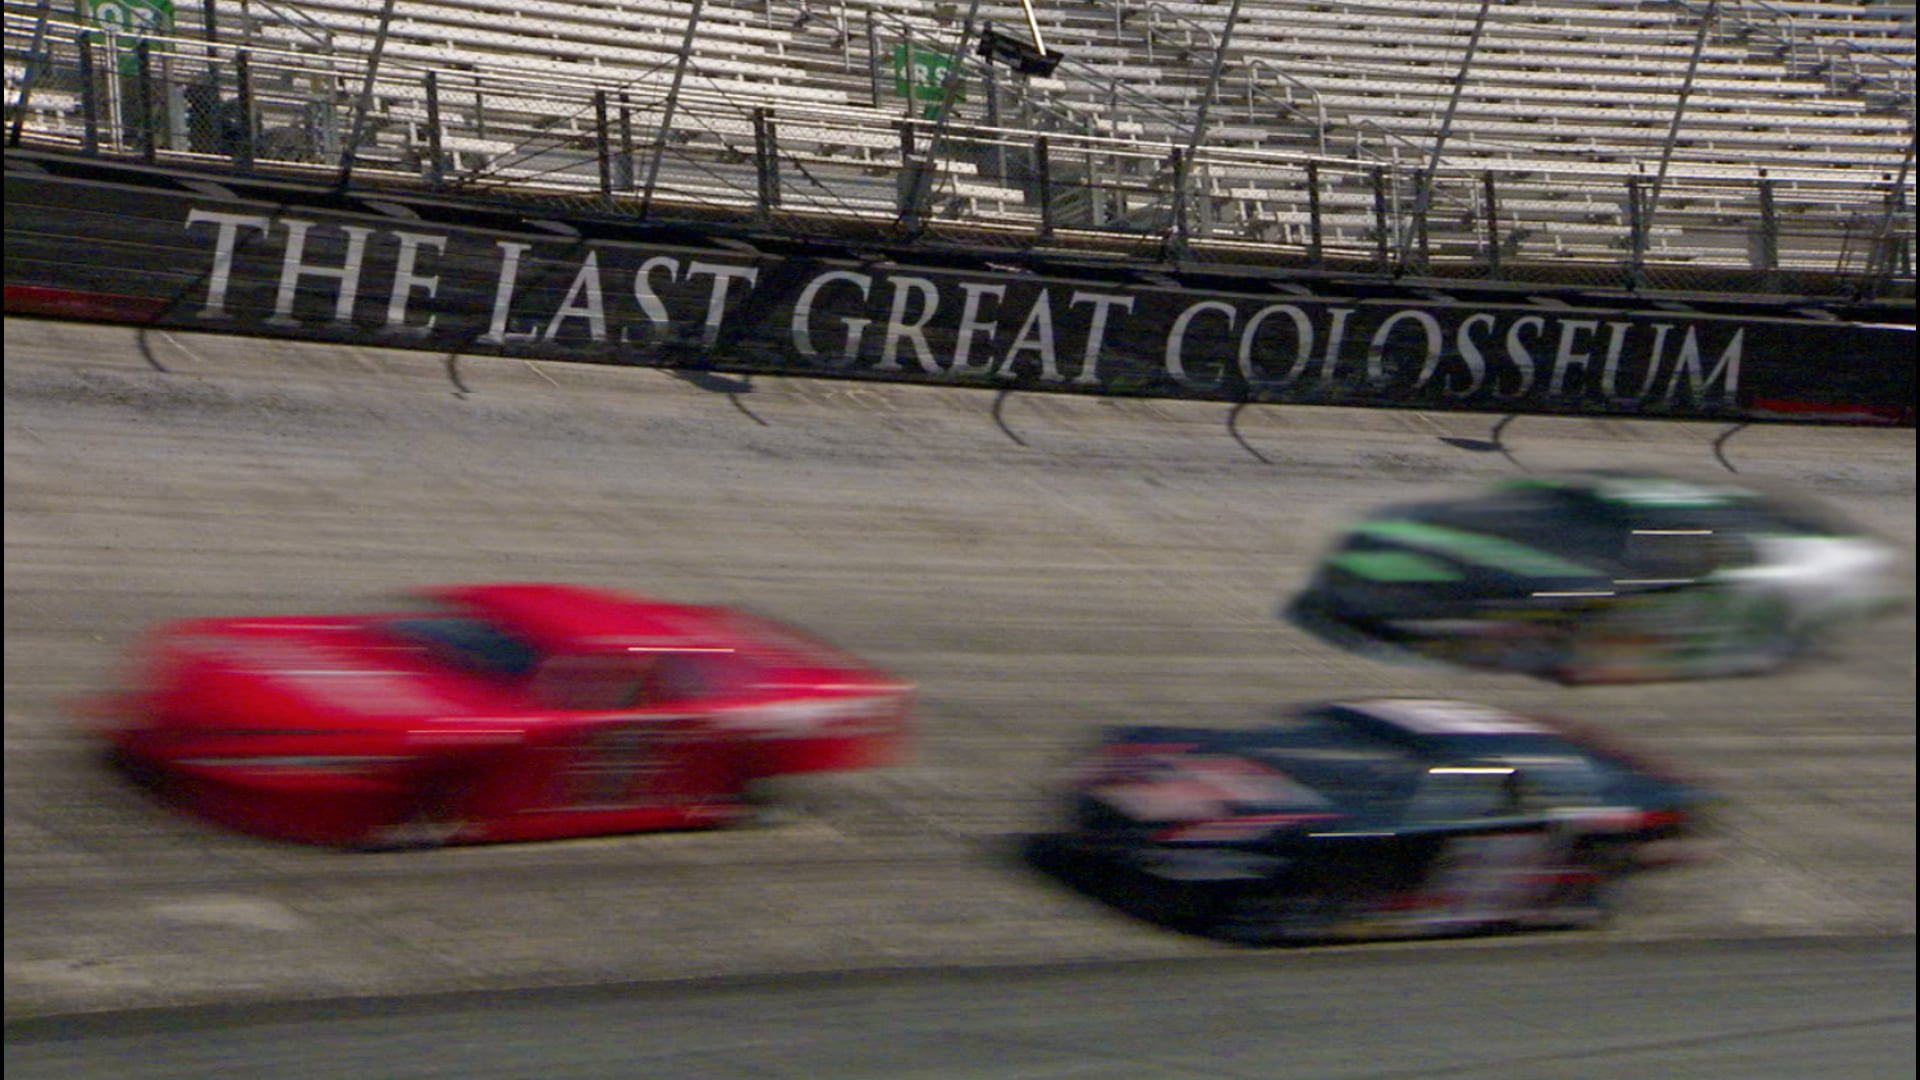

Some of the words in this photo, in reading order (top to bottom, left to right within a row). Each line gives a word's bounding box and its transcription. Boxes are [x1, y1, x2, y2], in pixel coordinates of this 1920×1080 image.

[185, 209, 447, 336] THE
[476, 241, 759, 347] LAST
[791, 270, 1135, 384] GREAT
[1165, 301, 1745, 404] COLOSSEUM
